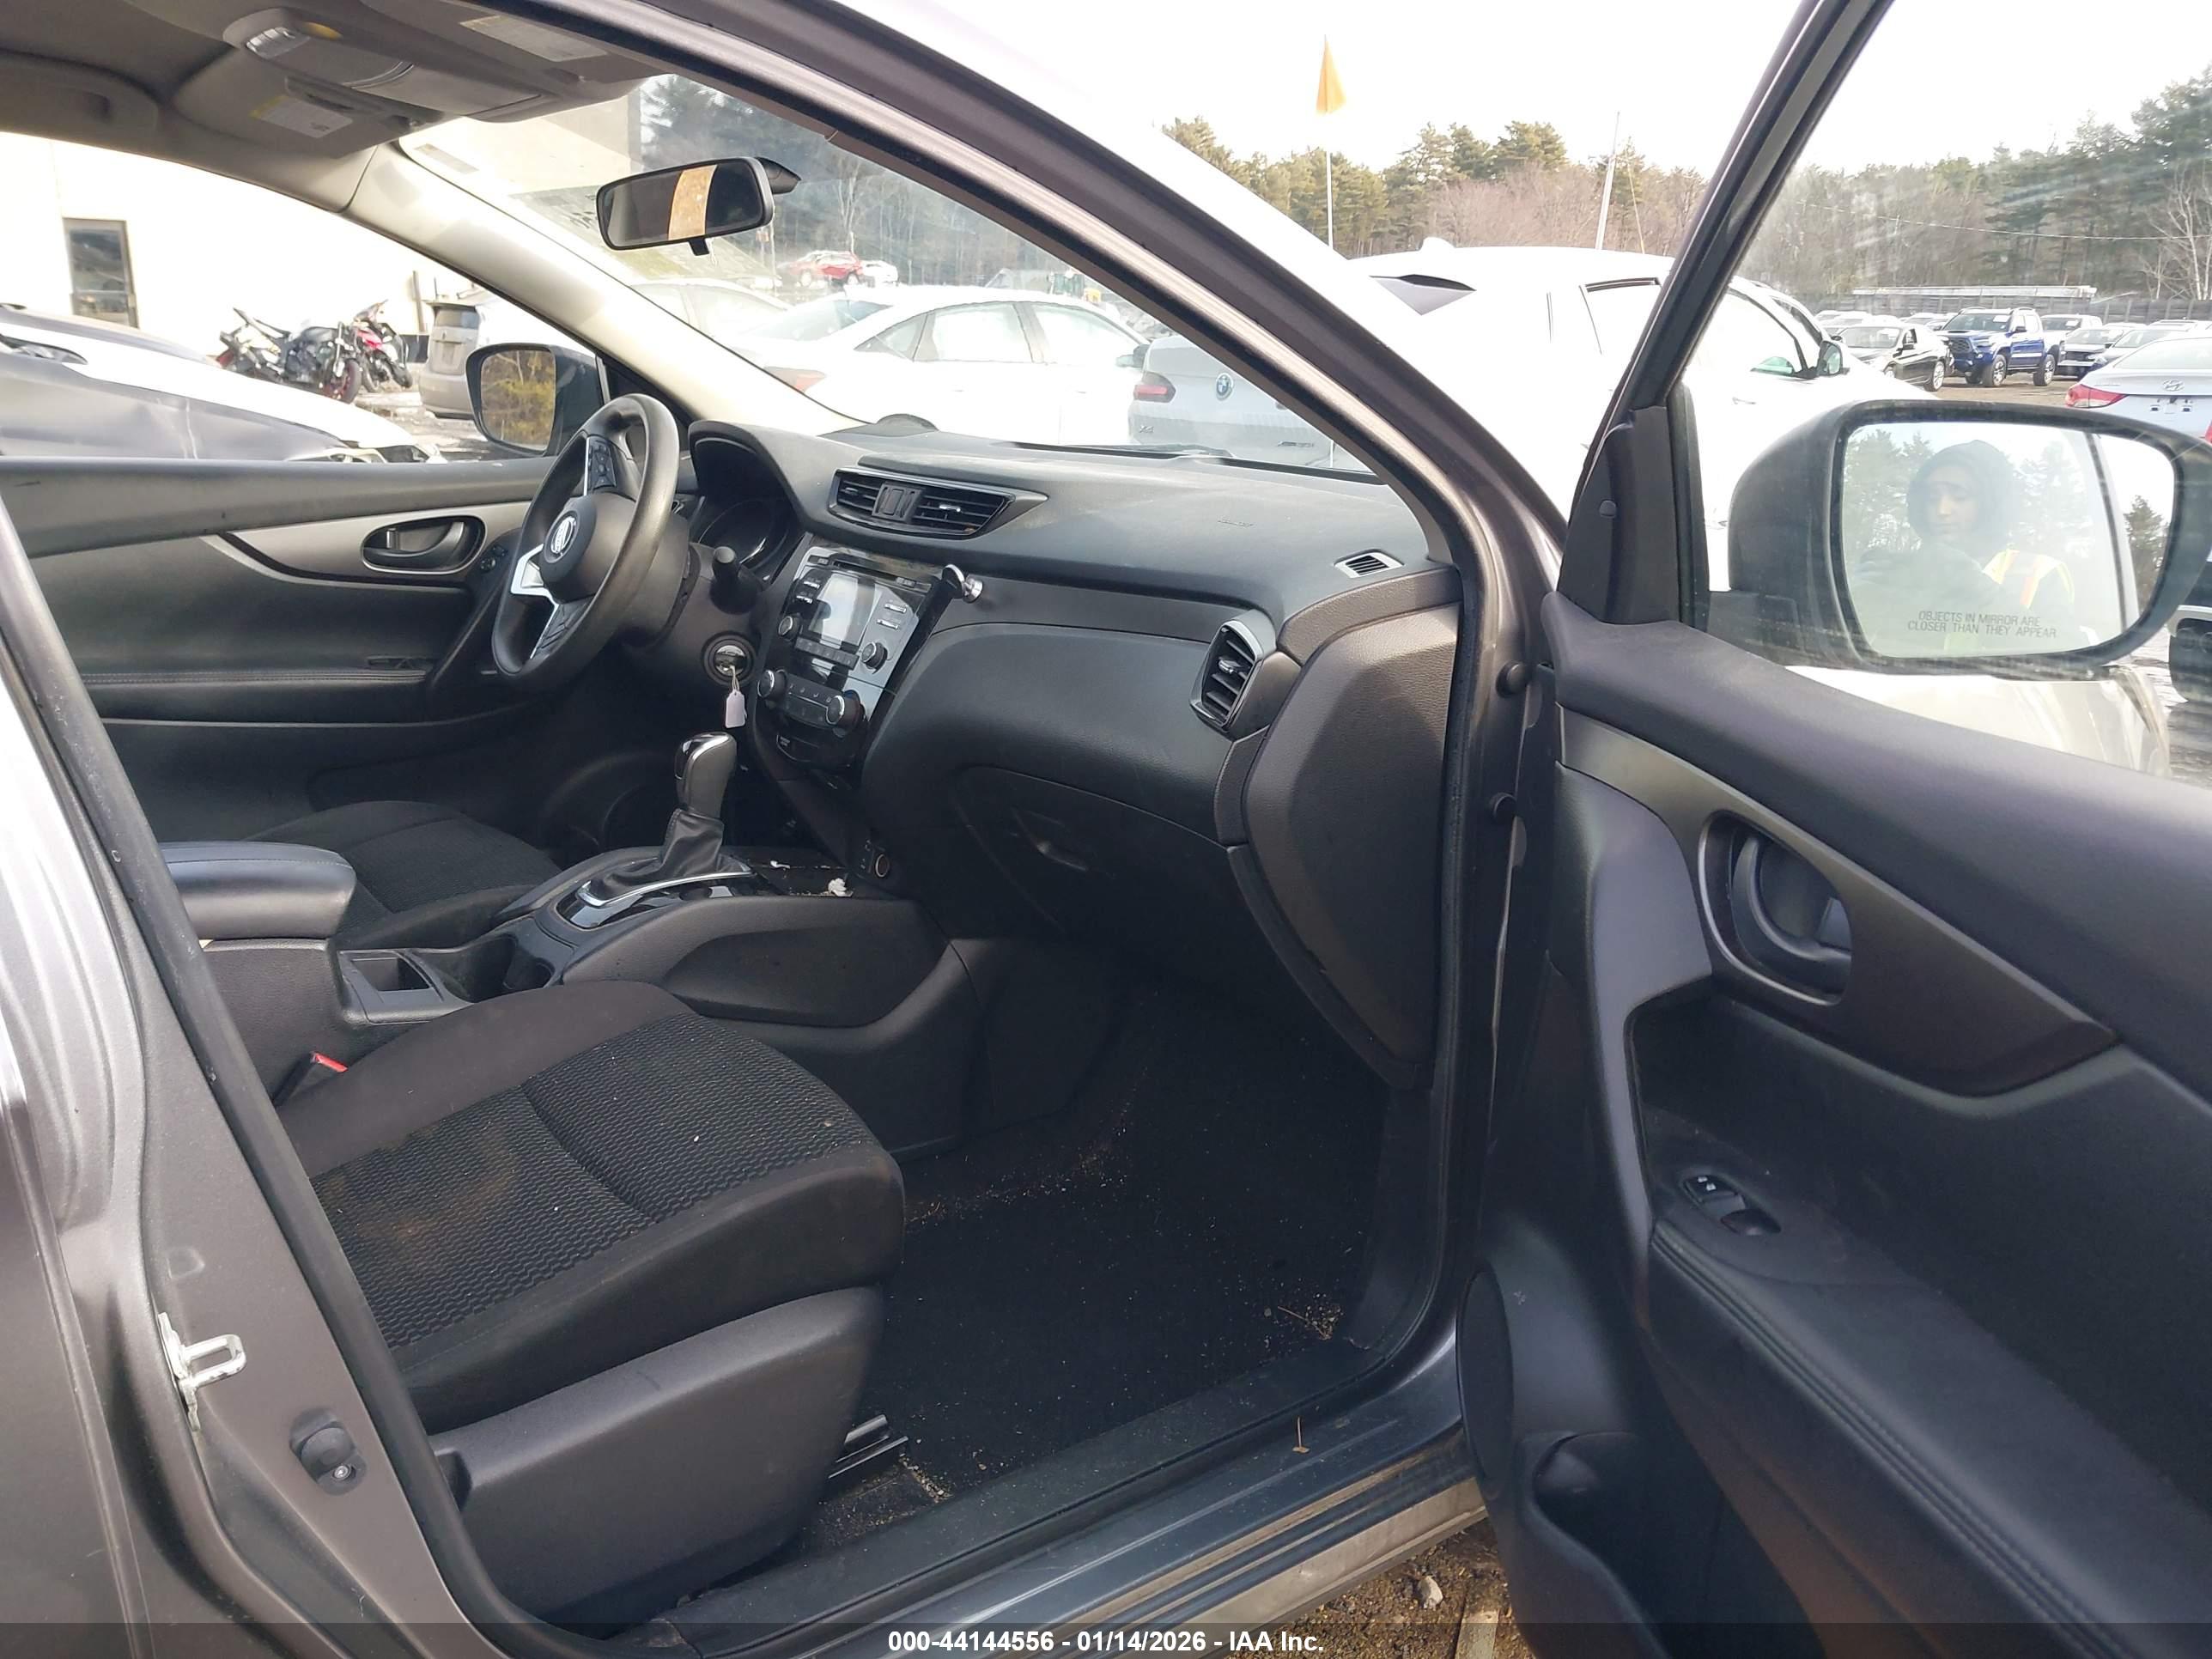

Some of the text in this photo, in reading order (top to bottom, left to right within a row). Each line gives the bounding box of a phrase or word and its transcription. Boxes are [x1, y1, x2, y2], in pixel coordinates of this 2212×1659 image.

[1918, 611, 2041, 627] OBJECTS IN MIRROR ARE
[1907, 620, 2057, 639] CLOSER THAN THEY APPEAR
